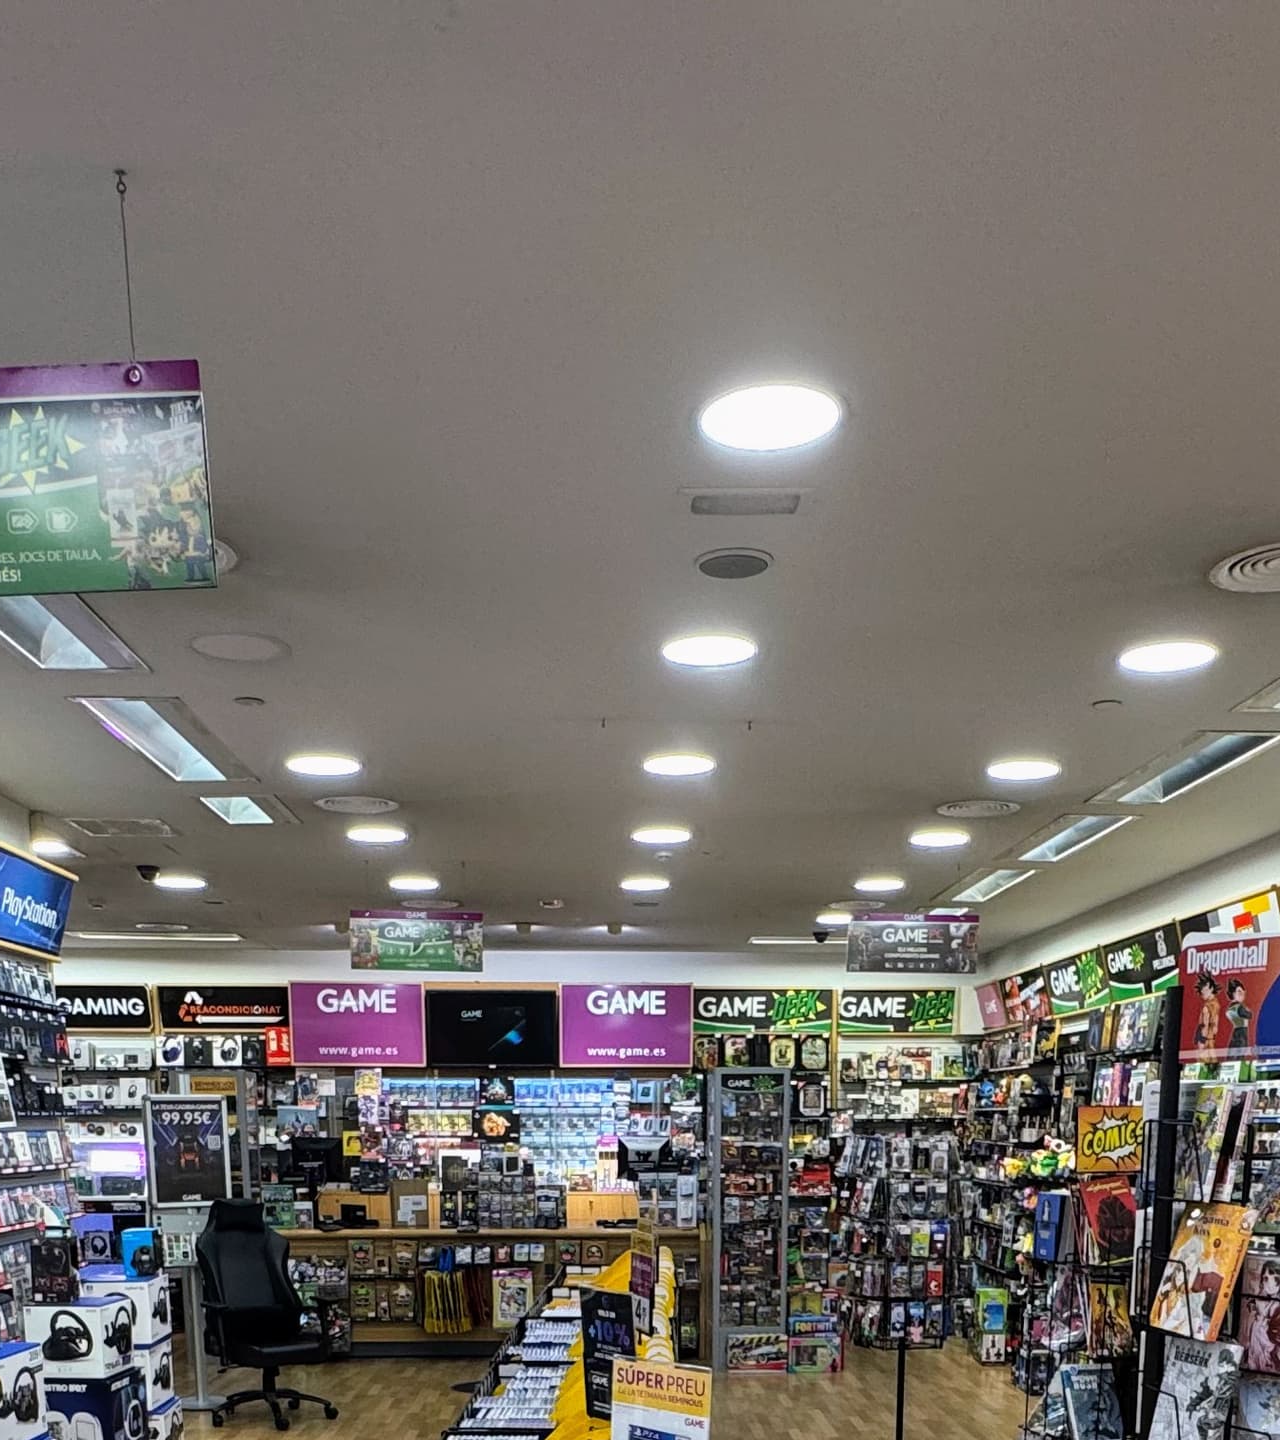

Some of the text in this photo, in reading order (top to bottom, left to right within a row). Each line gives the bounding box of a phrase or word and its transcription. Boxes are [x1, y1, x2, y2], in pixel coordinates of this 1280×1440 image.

[47, 551, 62, 562] DE
[2, 887, 57, 928] PlayStation
[384, 927, 419, 938] GAME
[882, 929, 928, 942] GAME
[1107, 948, 1133, 974] GAME
[1187, 940, 1269, 975] Dragonball
[1050, 966, 1079, 995] GAME
[55, 998, 145, 1016] GAMING
[190, 1005, 281, 1014] REACONDICIONAT
[317, 989, 397, 1014] GAME
[586, 990, 666, 1016] GAME
[698, 997, 766, 1019] GAME
[840, 996, 906, 1019] GAME
[461, 1010, 483, 1018] GAME
[319, 1045, 399, 1058] www.game.es
[587, 1046, 666, 1059] www.game.es
[728, 1079, 751, 1088] GAME
[162, 1112, 212, 1125] 99.95€
[1082, 1118, 1144, 1156] COMICS
[617, 1365, 705, 1397] SÚPER PREU
[684, 1417, 705, 1429] GAME
